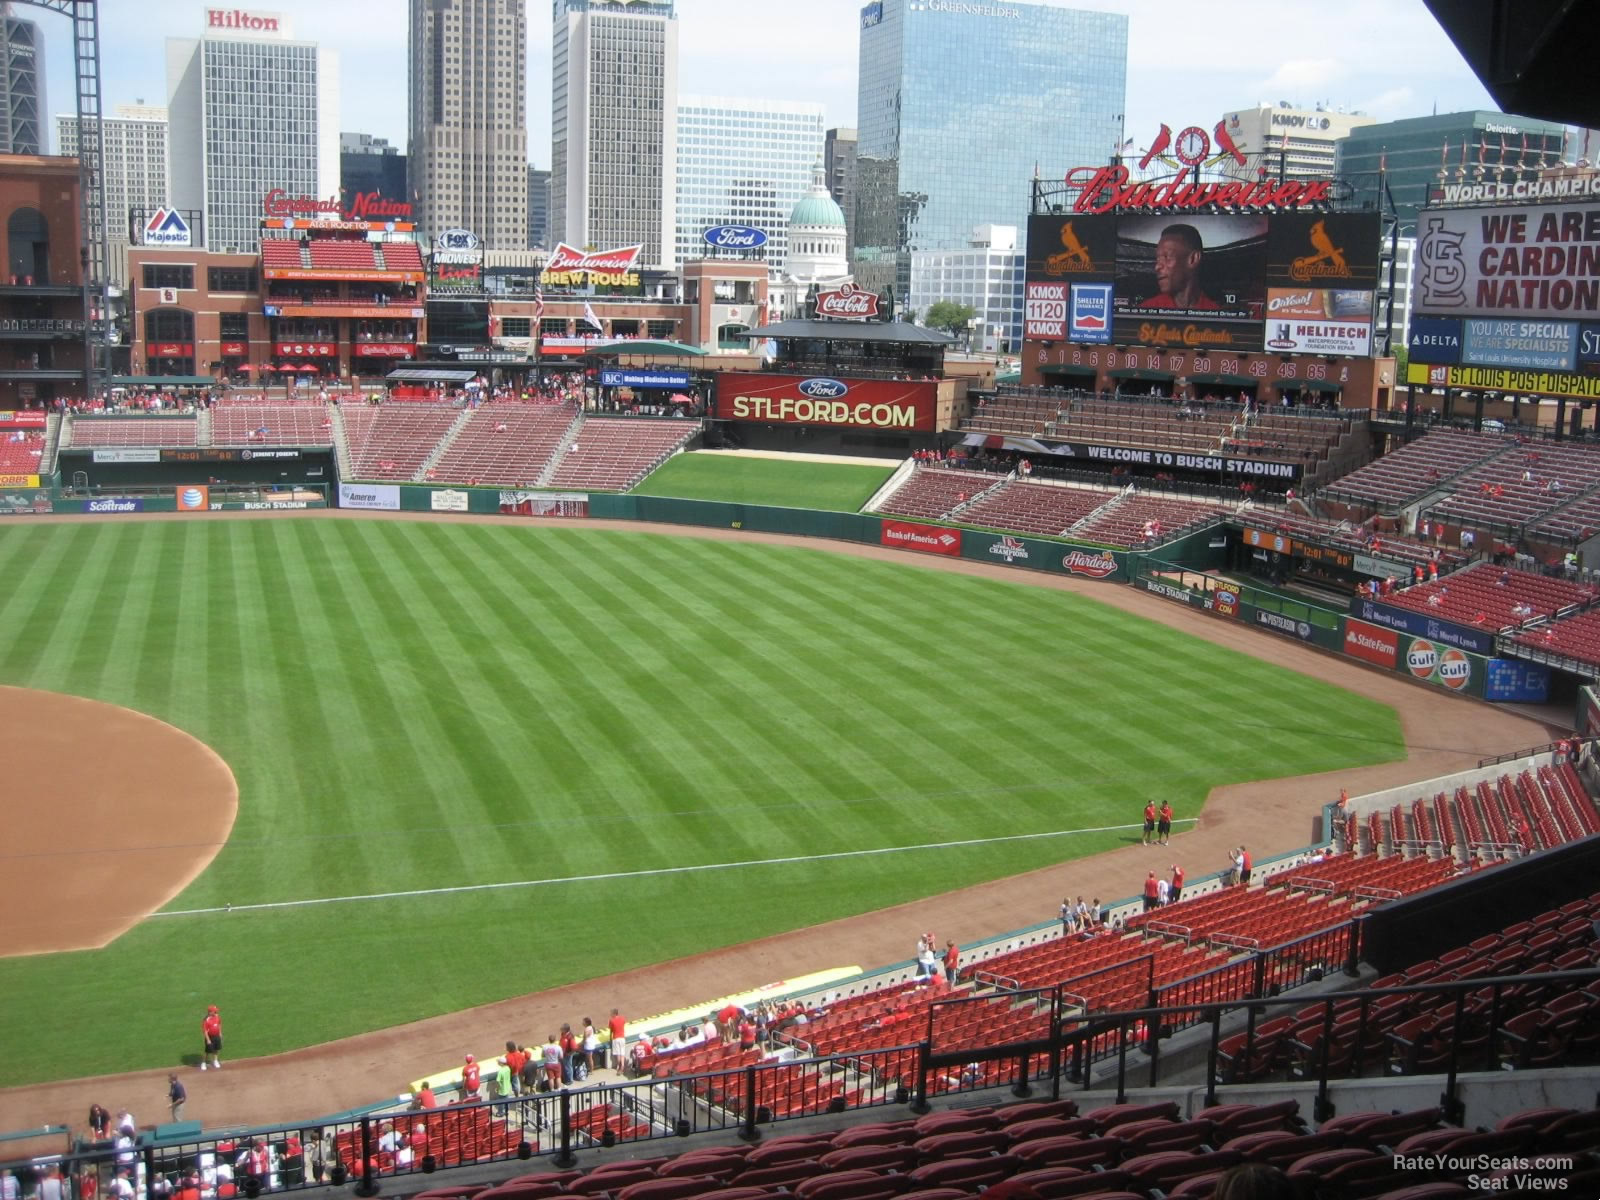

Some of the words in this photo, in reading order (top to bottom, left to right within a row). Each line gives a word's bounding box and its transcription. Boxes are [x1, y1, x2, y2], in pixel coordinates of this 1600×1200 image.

[929, 0, 1021, 19] GREENSFELDER
[208, 10, 279, 31] Hilton
[862, 11, 879, 29] KPMG
[1272, 114, 1306, 127] KMOV
[1065, 164, 1333, 213] Budweiser
[1445, 183, 1509, 203] WORLD
[264, 188, 344, 217] Cardinals
[345, 191, 413, 219] Nation
[309, 220, 329, 229] AT&T
[330, 221, 371, 230] ROOFTOP
[1481, 214, 1527, 244] WE
[1536, 211, 1600, 243] ARE
[146, 231, 189, 243] Majestic
[447, 233, 469, 244] FOX
[717, 228, 754, 245] Ford
[434, 253, 482, 264] MIDWEST
[550, 250, 637, 270] Budweiser
[439, 264, 480, 280] Live!
[1289, 257, 1352, 282] Cardinals
[540, 271, 585, 285] BREW
[588, 271, 640, 286] HOUSE
[1029, 286, 1064, 299] KMOX
[1225, 294, 1236, 304] 10
[1476, 279, 1600, 310] NATION
[1029, 303, 1064, 319] 1120
[1028, 321, 1062, 335] KMOX
[1183, 324, 1233, 346] Cardinals
[1296, 325, 1367, 339] HELITECH
[1471, 322, 1492, 336] YOU
[1495, 323, 1516, 337] ARE
[1520, 323, 1570, 339] SPECIAL
[1423, 335, 1458, 347] DELTA
[1470, 336, 1485, 348] WE
[1486, 337, 1501, 349] ARE
[1504, 338, 1569, 353] SPECIALISTS
[1059, 350, 1064, 363] 1
[1073, 351, 1081, 364] 2
[1089, 352, 1098, 365] 6
[1107, 353, 1116, 366] 9
[1125, 354, 1138, 368] 10
[1146, 355, 1160, 369] 14
[1170, 356, 1184, 370] 17
[1193, 358, 1211, 373] 20
[1220, 360, 1239, 375] 24
[1249, 361, 1267, 376] 42
[1277, 362, 1296, 378] 45
[1307, 364, 1326, 379] 85
[1468, 352, 1484, 361] Saint
[1485, 353, 1500, 362] Louis
[1501, 353, 1531, 366] University
[1532, 355, 1559, 368] Hospital
[605, 373, 620, 383] BJC
[624, 375, 643, 383] Making
[1431, 367, 1446, 380] stl
[1451, 367, 1467, 385] ST.
[1469, 368, 1504, 388] LOUIS
[807, 381, 838, 396] Ford
[733, 396, 915, 427] STLFORD.COM
[177, 452, 199, 460] 12:01
[1087, 446, 1151, 463] WELCOME
[1155, 453, 1172, 465] TO
[1176, 454, 1222, 470] BUSCH
[1226, 460, 1293, 477] STADIUM
[349, 492, 376, 501] Ameren
[90, 500, 135, 511] Scottrade
[273, 501, 306, 509] STADIUM
[887, 529, 904, 540] Bank
[910, 533, 938, 545] America
[989, 547, 1029, 559] CHAMPIONS
[1304, 546, 1321, 559] 12:01
[1356, 561, 1372, 571] Mercy
[1148, 581, 1165, 595] BUSCH
[1166, 587, 1190, 603] STADIUM
[1215, 581, 1240, 594] STLFORD
[1268, 613, 1296, 633] POSTSEASON
[1374, 611, 1390, 623] Merrill
[1391, 616, 1408, 629] Lynch
[1439, 631, 1458, 644] Merrill
[1459, 636, 1478, 649] Lynch
[1408, 653, 1435, 666] Gulf
[1440, 663, 1467, 675] Gulf
[469, 1071, 476, 1081] 4
